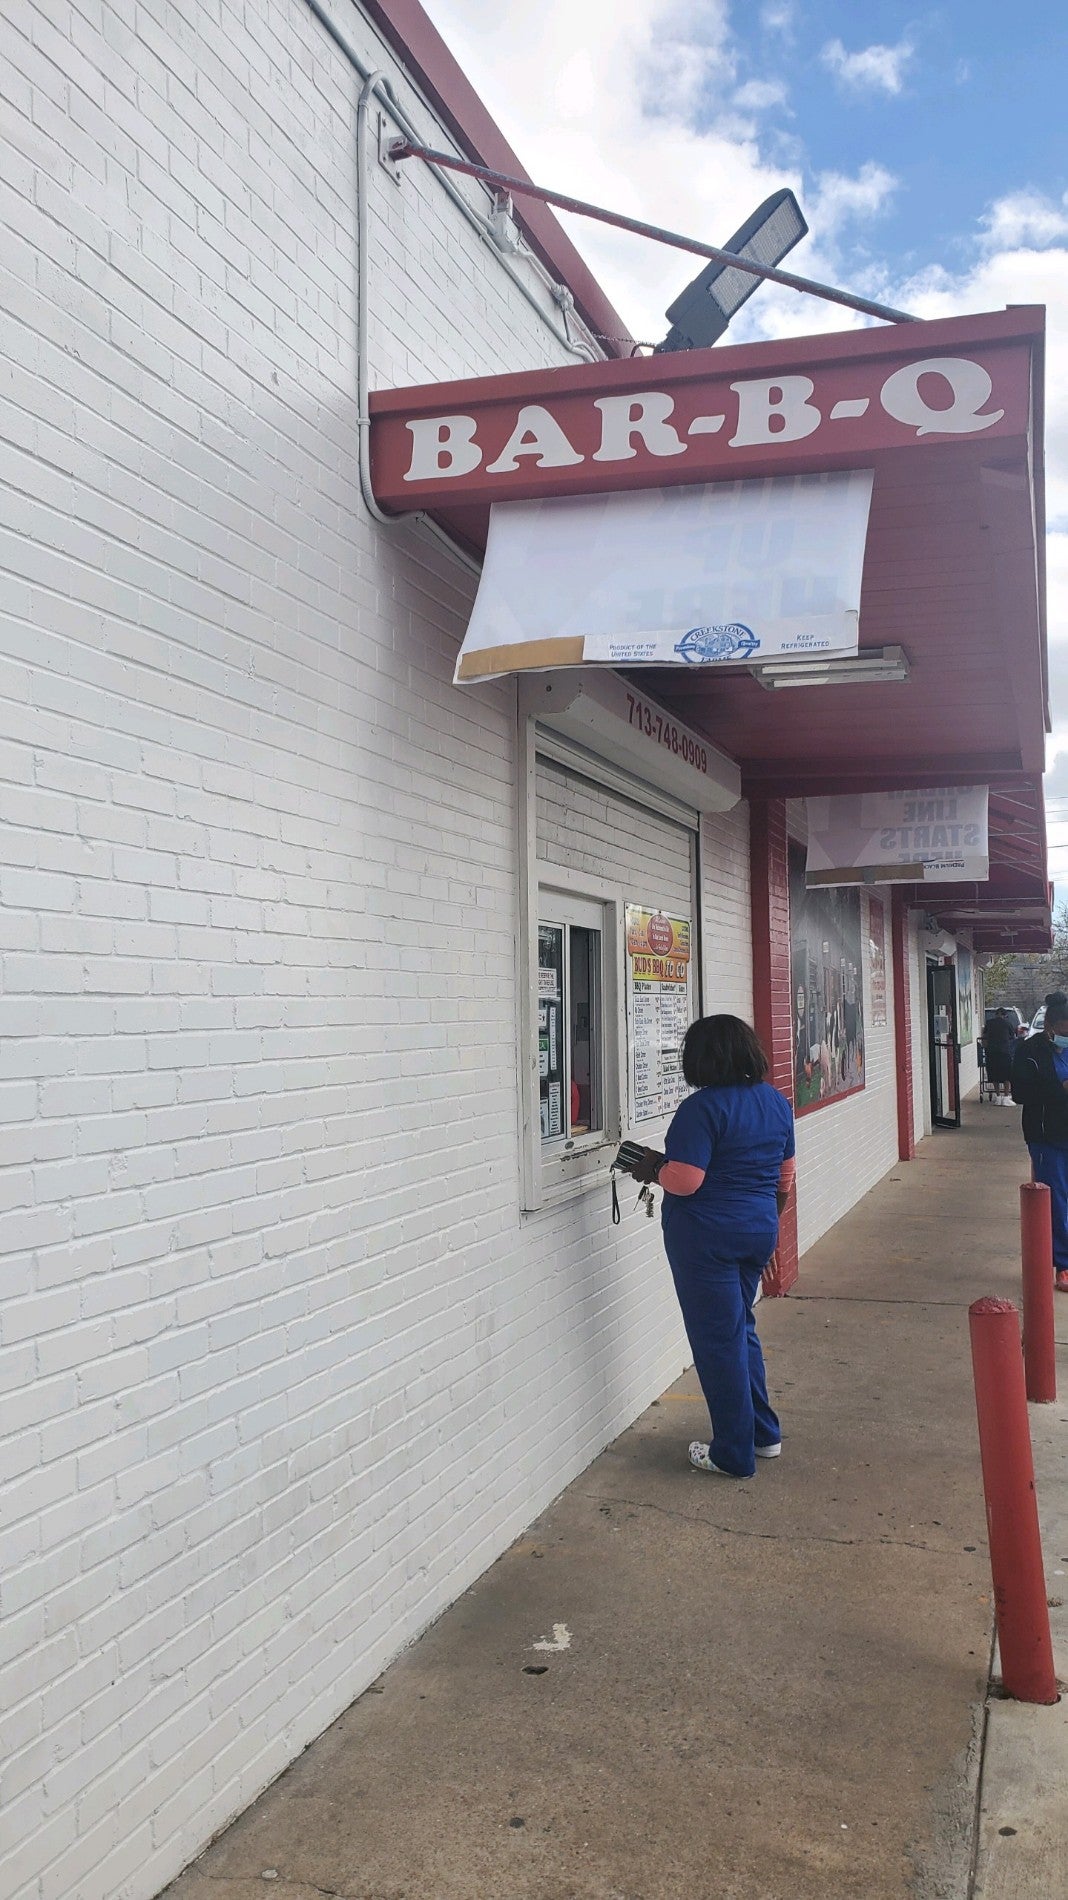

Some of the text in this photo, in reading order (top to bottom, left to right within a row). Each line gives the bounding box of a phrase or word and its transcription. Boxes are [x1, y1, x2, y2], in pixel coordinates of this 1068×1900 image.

[402, 356, 1005, 482] BAR-B-Q
[690, 625, 746, 642] CREEKSTONE
[626, 692, 707, 774] 713-748-0909
